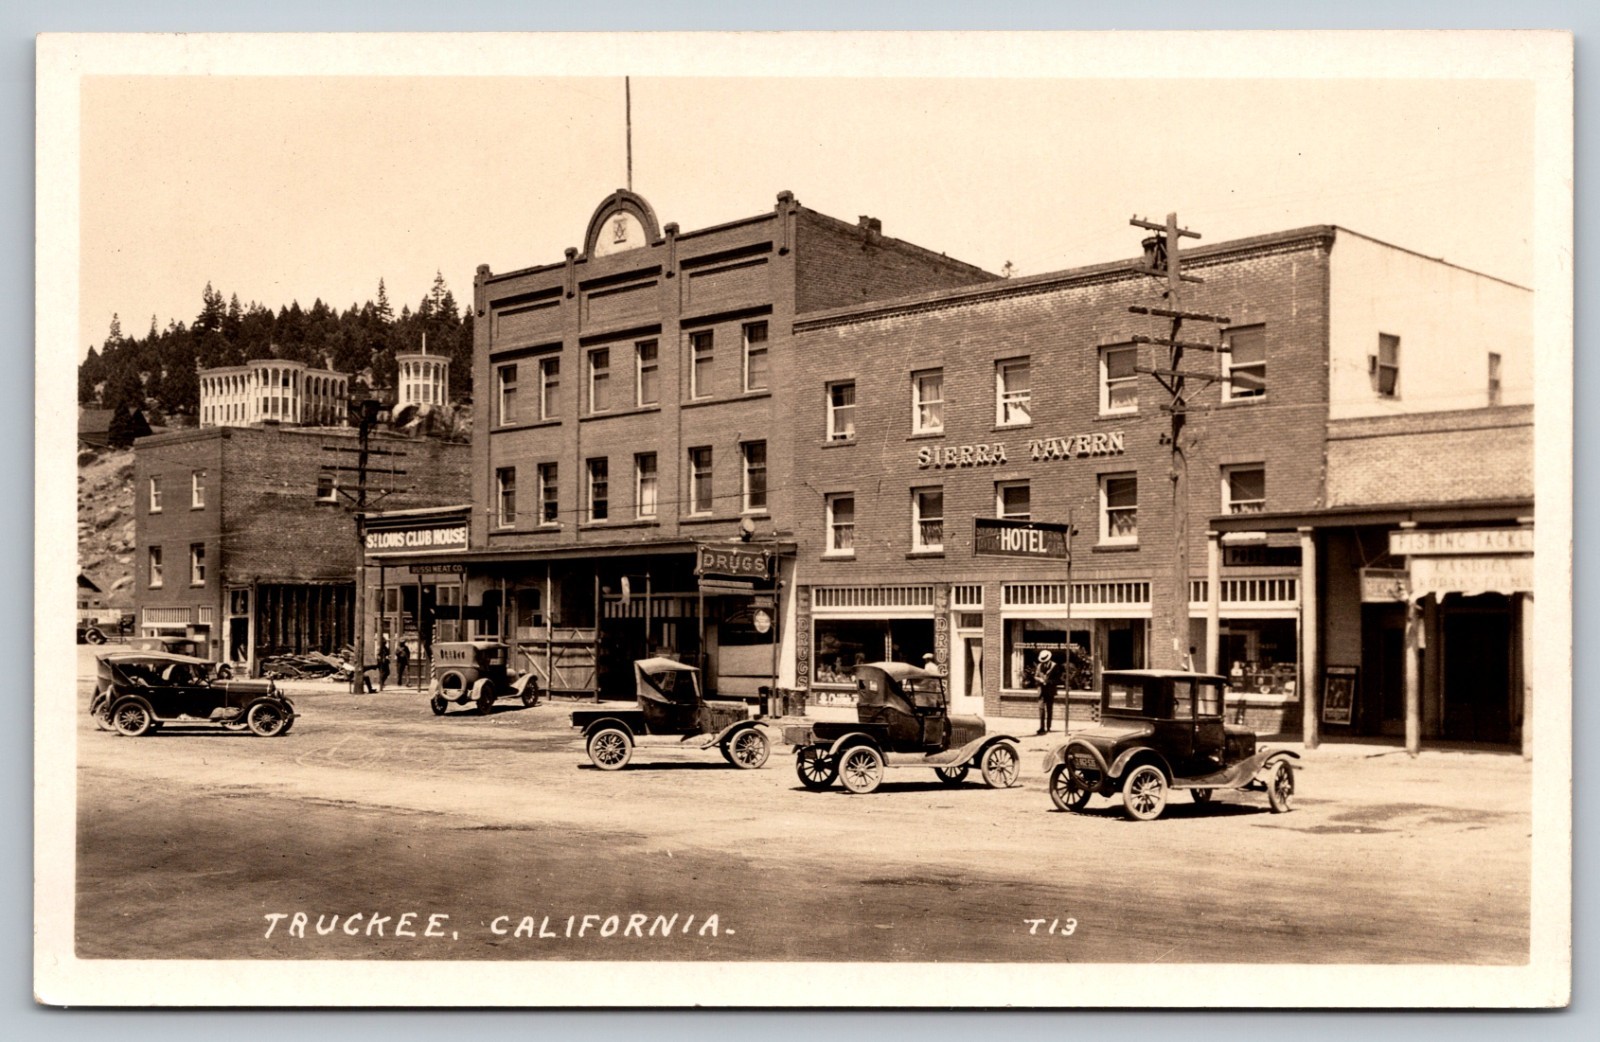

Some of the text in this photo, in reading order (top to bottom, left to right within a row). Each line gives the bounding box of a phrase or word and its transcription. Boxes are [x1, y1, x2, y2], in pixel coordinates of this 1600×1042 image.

[917, 431, 1125, 469] SIERRA TAVERN
[378, 531, 405, 548] LOUIS
[406, 529, 432, 547] CLUB
[433, 527, 466, 545] HOUSE
[1000, 527, 1048, 553] HOTEL
[703, 554, 765, 572] DRUGS
